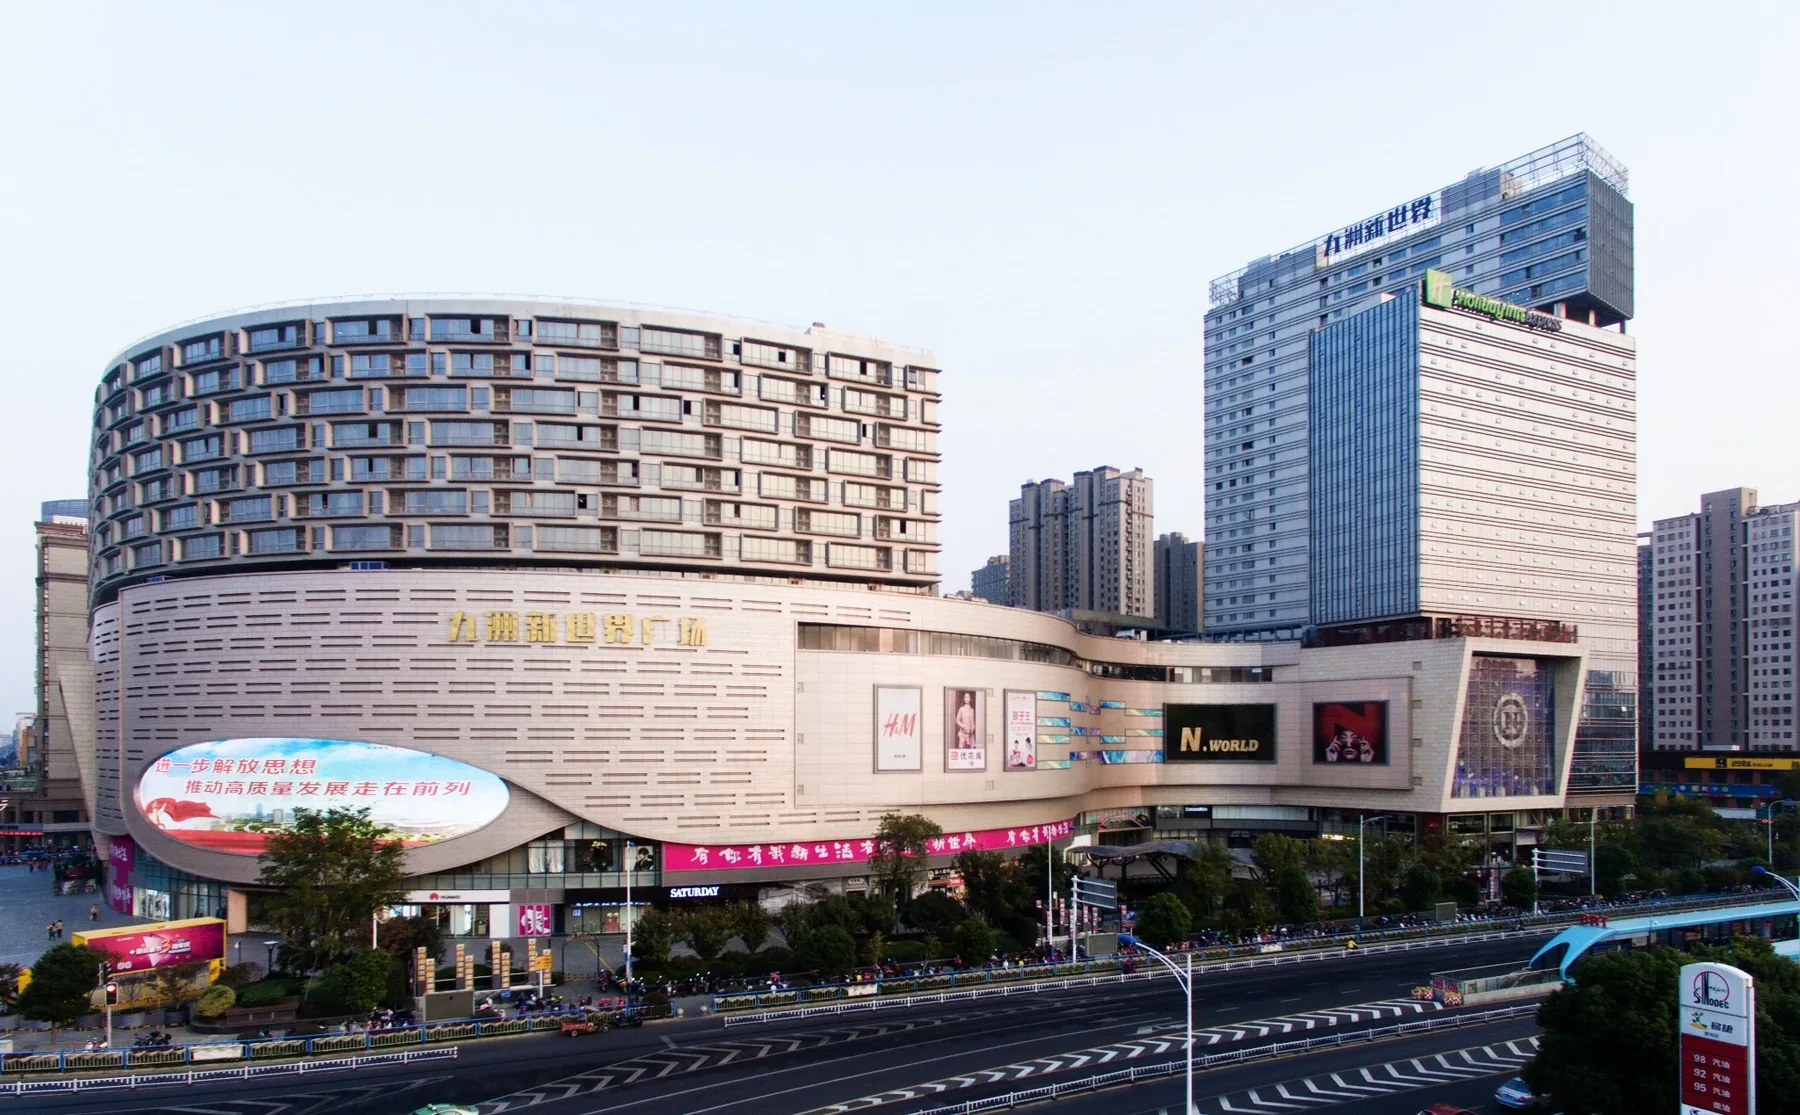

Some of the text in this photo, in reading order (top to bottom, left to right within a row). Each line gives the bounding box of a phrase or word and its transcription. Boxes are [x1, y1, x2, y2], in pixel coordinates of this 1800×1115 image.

[1323, 195, 1432, 258] 九洲新世界
[1453, 289, 1504, 319] Holiday
[1505, 301, 1526, 321] Inn
[448, 609, 709, 647] 九洲新世界广场
[883, 713, 917, 738] H&M
[154, 757, 317, 775] 进一步解放思想
[184, 780, 473, 797] 推动高质量发展走在前列
[860, 832, 977, 855] 有新世界
[690, 842, 855, 866] 有你有我新生活
[670, 886, 720, 898] SATURDAY
[1711, 1021, 1734, 1034] 易捷
[1693, 1054, 1706, 1064] 98
[1693, 1068, 1706, 1078] 92
[1693, 1082, 1707, 1092] 95
